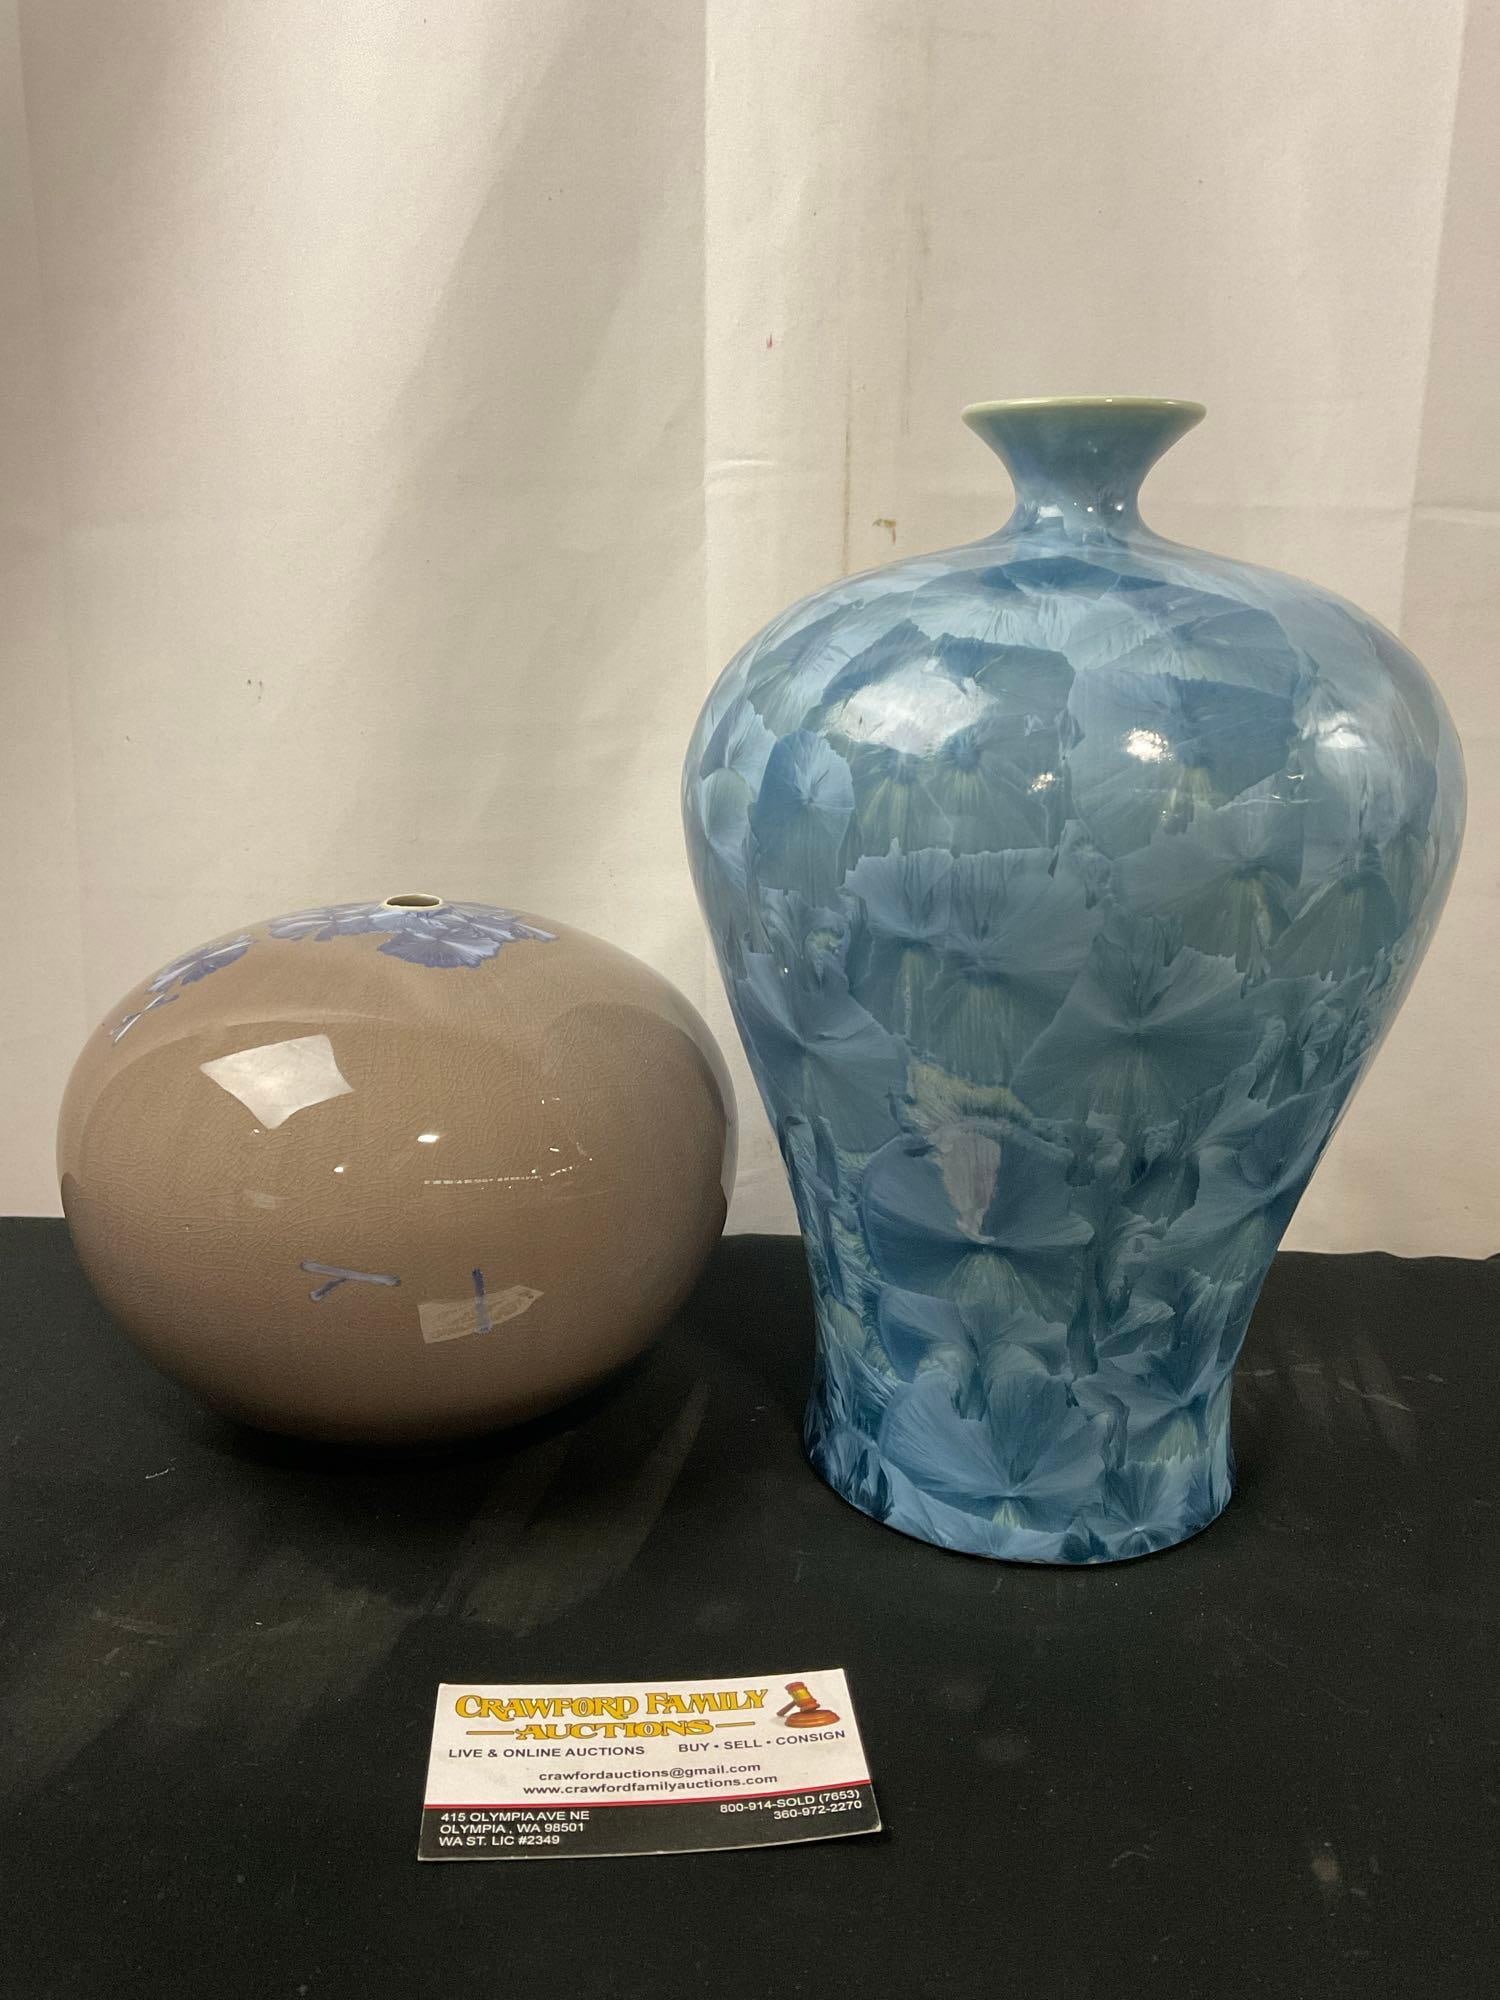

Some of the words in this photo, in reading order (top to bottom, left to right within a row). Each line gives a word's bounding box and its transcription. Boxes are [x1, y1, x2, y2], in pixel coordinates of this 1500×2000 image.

[455, 1694, 639, 1722] CRAWFORD
[645, 1688, 768, 1715] FAMILY
[514, 1720, 714, 1740] AUCTIONS
[678, 1742, 710, 1753] BUY
[724, 1739, 762, 1749] SELL
[775, 1730, 846, 1746] CONSIGN
[448, 1749, 483, 1758] LIVE
[487, 1748, 497, 1757] &
[503, 1747, 561, 1757] ONLINE
[565, 1746, 645, 1756] AUCTIONS
[539, 1763, 761, 1781] crawfordauctions@gmail.com
[523, 1775, 778, 1795] www.crawfordfamilyauctions.com
[720, 1795, 815, 1813] 800-914-SOLD
[818, 1789, 860, 1805] (7653)
[773, 1800, 862, 1820] 360-972-2270
[441, 1812, 466, 1821] 415
[470, 1811, 534, 1821] OLYMPIA
[570, 1811, 590, 1820] NE
[440, 1824, 506, 1834] OLYMPIA
[517, 1823, 541, 1833] WA
[544, 1823, 584, 1833] 98501
[439, 1836, 463, 1846] WA
[465, 1836, 488, 1846] ST.
[491, 1835, 514, 1845] LIC
[517, 1835, 560, 1845] #2349
